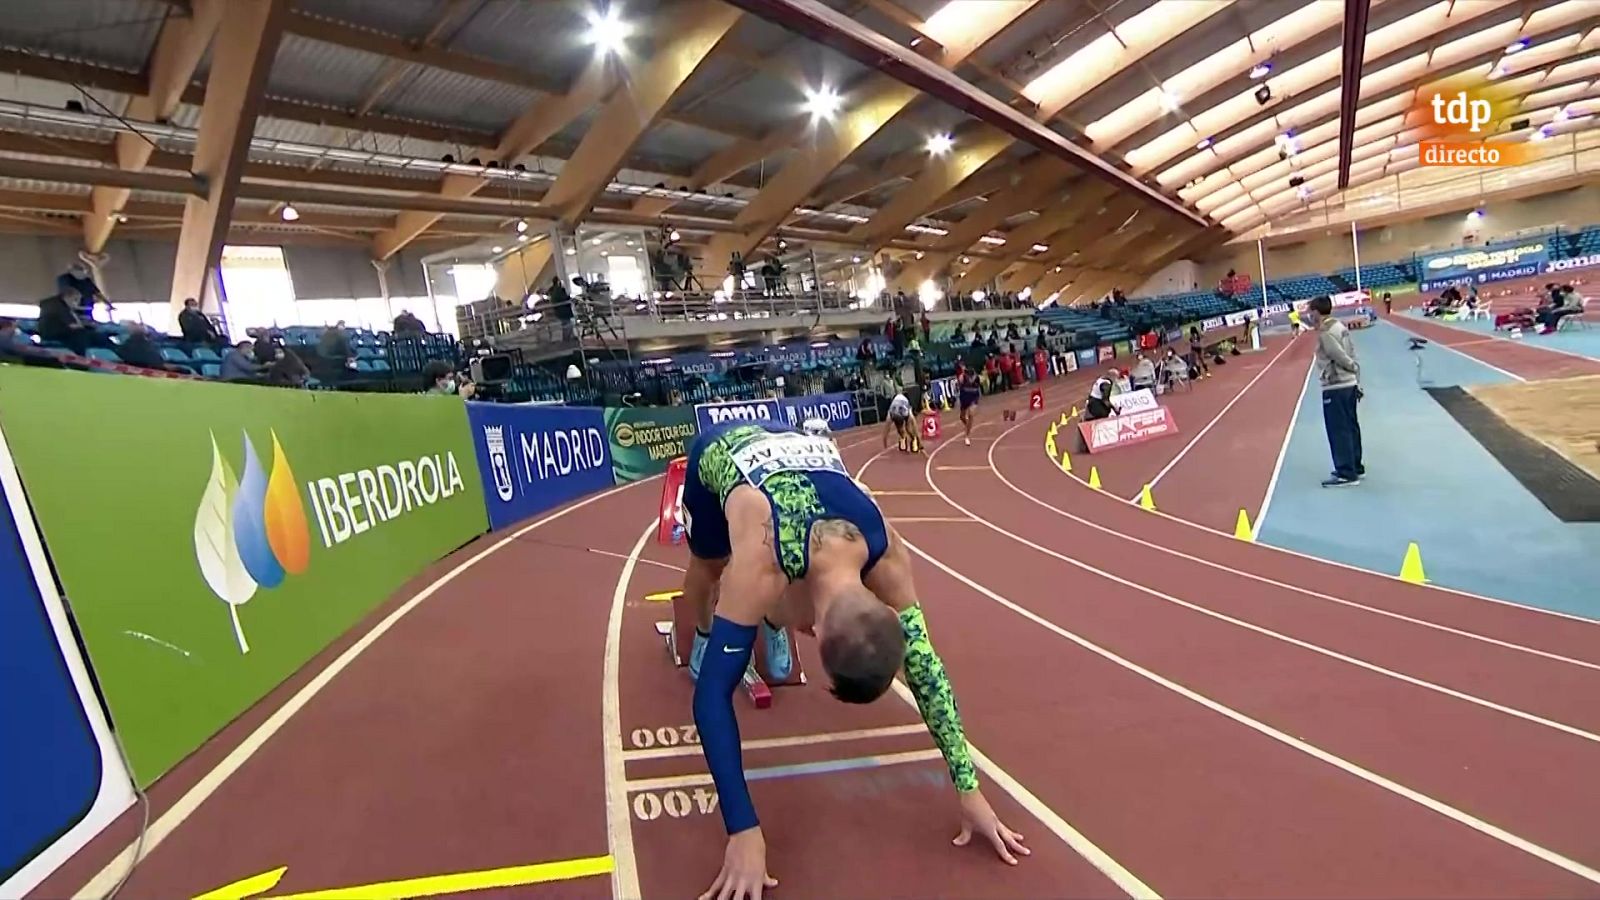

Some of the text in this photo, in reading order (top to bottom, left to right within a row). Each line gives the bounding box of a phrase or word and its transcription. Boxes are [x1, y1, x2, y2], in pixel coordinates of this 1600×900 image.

[1491, 266, 1535, 281] MADRID
[1032, 394, 1041, 408] 2
[803, 401, 851, 424] MADRID
[634, 423, 695, 444] INDOOR TOUR GOLD
[927, 417, 937, 435] 3
[520, 427, 604, 484] MADRID
[648, 440, 686, 460] MADRID 21
[307, 450, 465, 548] IBERDROLA
[631, 724, 702, 748] 200
[633, 788, 719, 820] 400
